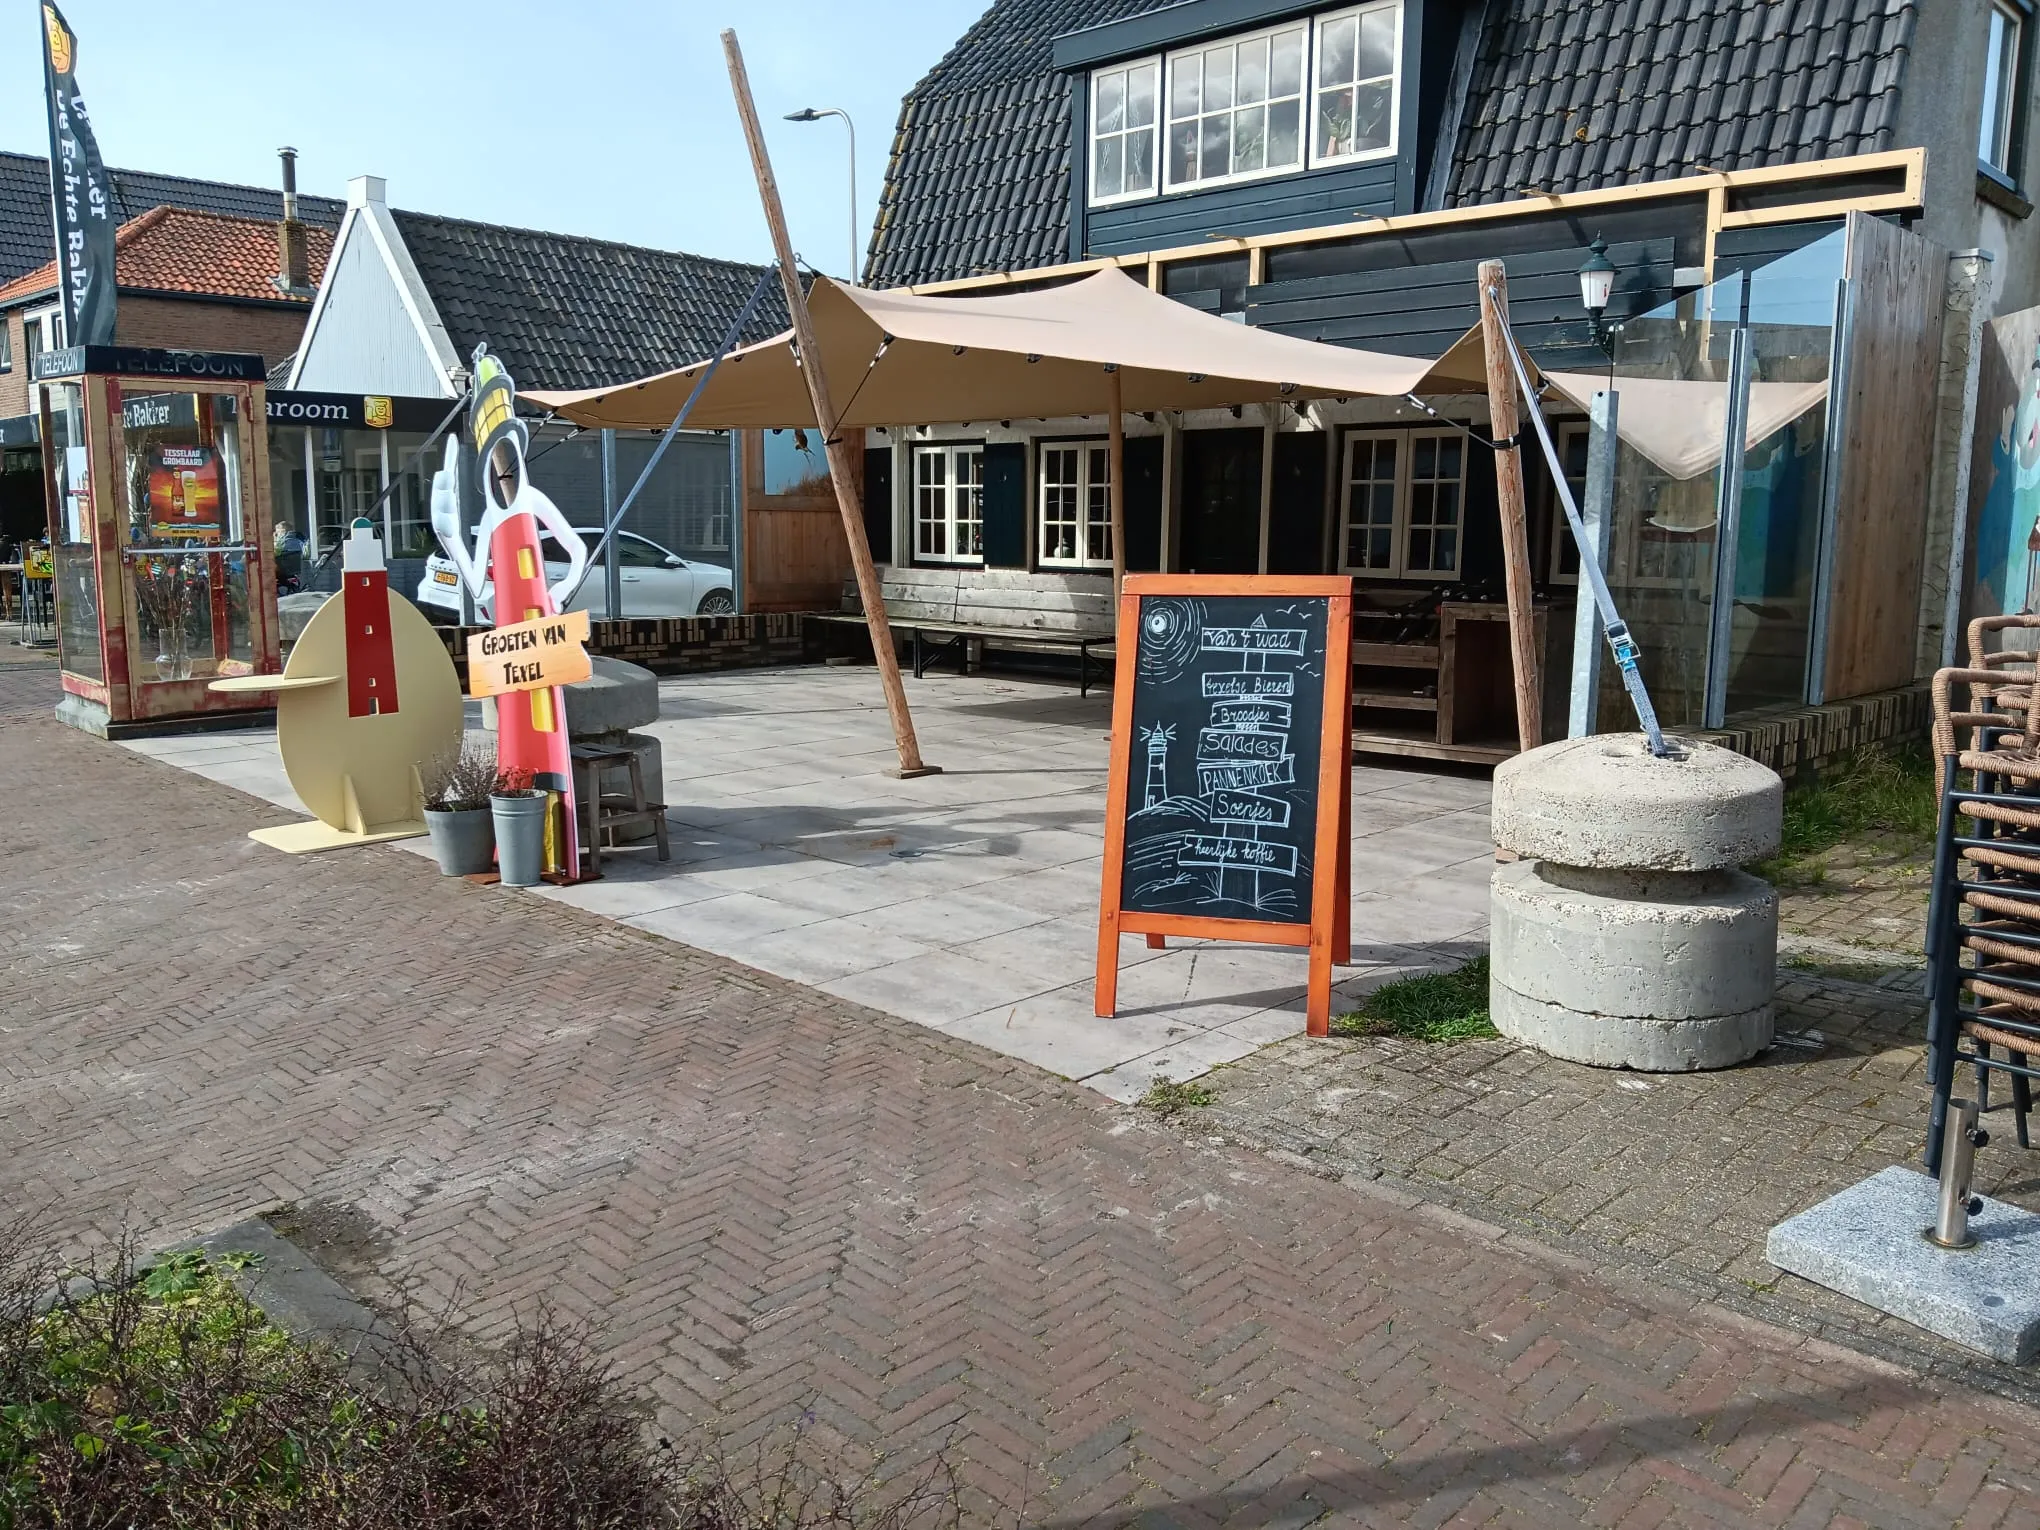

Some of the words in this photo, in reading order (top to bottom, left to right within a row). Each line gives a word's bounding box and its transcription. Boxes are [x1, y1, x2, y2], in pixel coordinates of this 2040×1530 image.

[61, 138, 81, 222] Echte
[68, 228, 87, 321] Bakk
[41, 353, 78, 375] TELEFOON
[164, 449, 200, 457] TESSELAAR
[1220, 705, 1270, 723] Broodjes
[1205, 733, 1280, 758] Salades
[1203, 762, 1282, 794] PANNENKOEK
[1217, 793, 1273, 821] Soepjes
